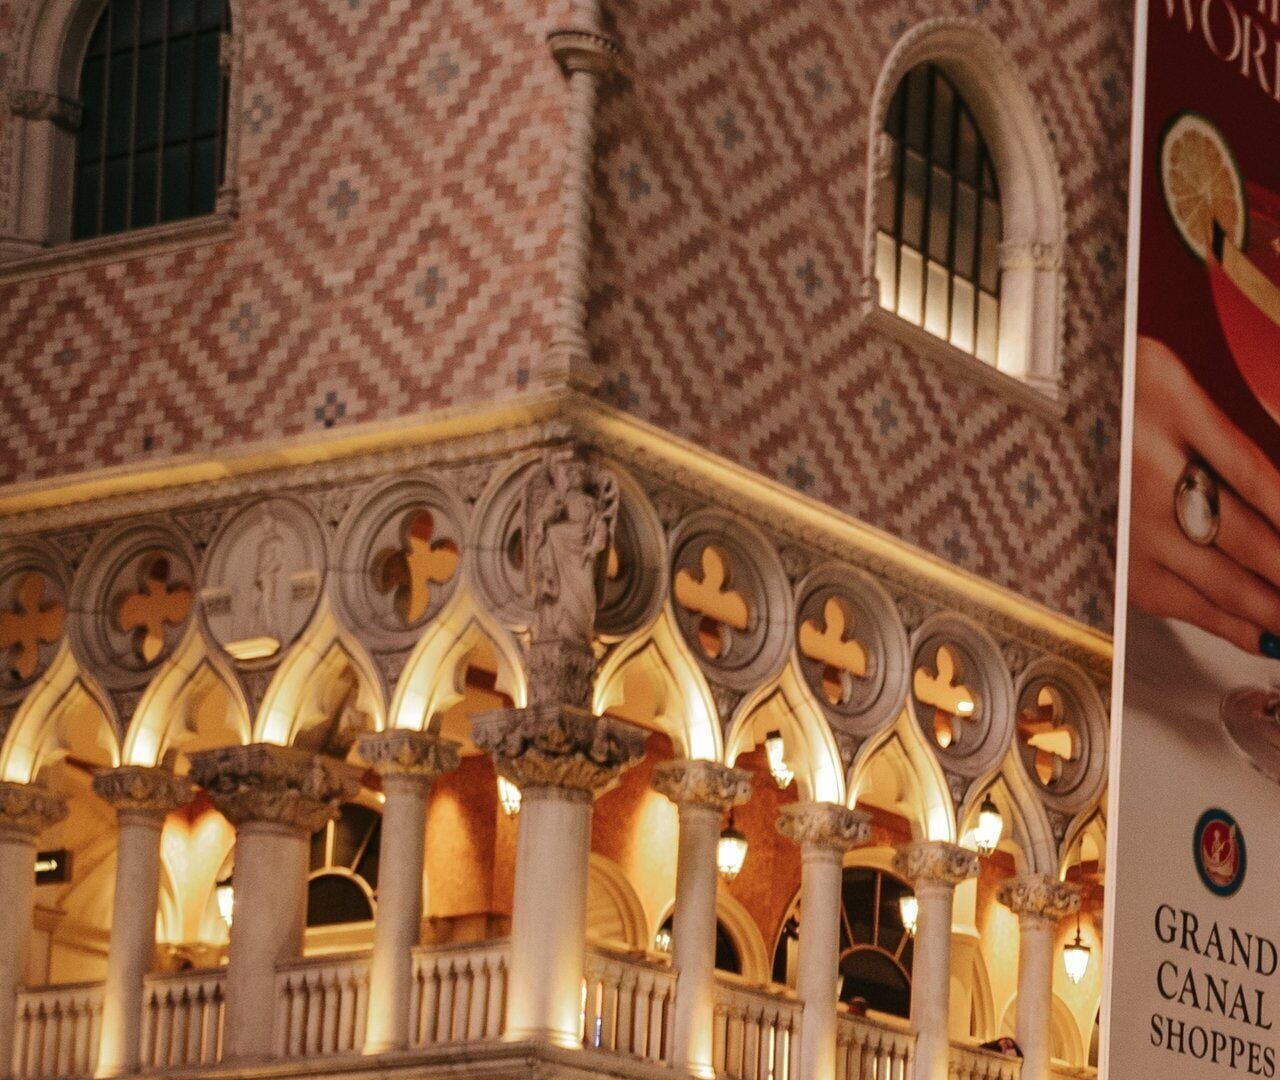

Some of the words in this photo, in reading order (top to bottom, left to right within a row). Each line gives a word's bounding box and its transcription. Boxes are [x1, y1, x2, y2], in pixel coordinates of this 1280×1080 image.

[1154, 904, 1278, 976] GRAND
[1156, 960, 1273, 1030] CANAL
[1150, 1013, 1275, 1078] SHOPPES
